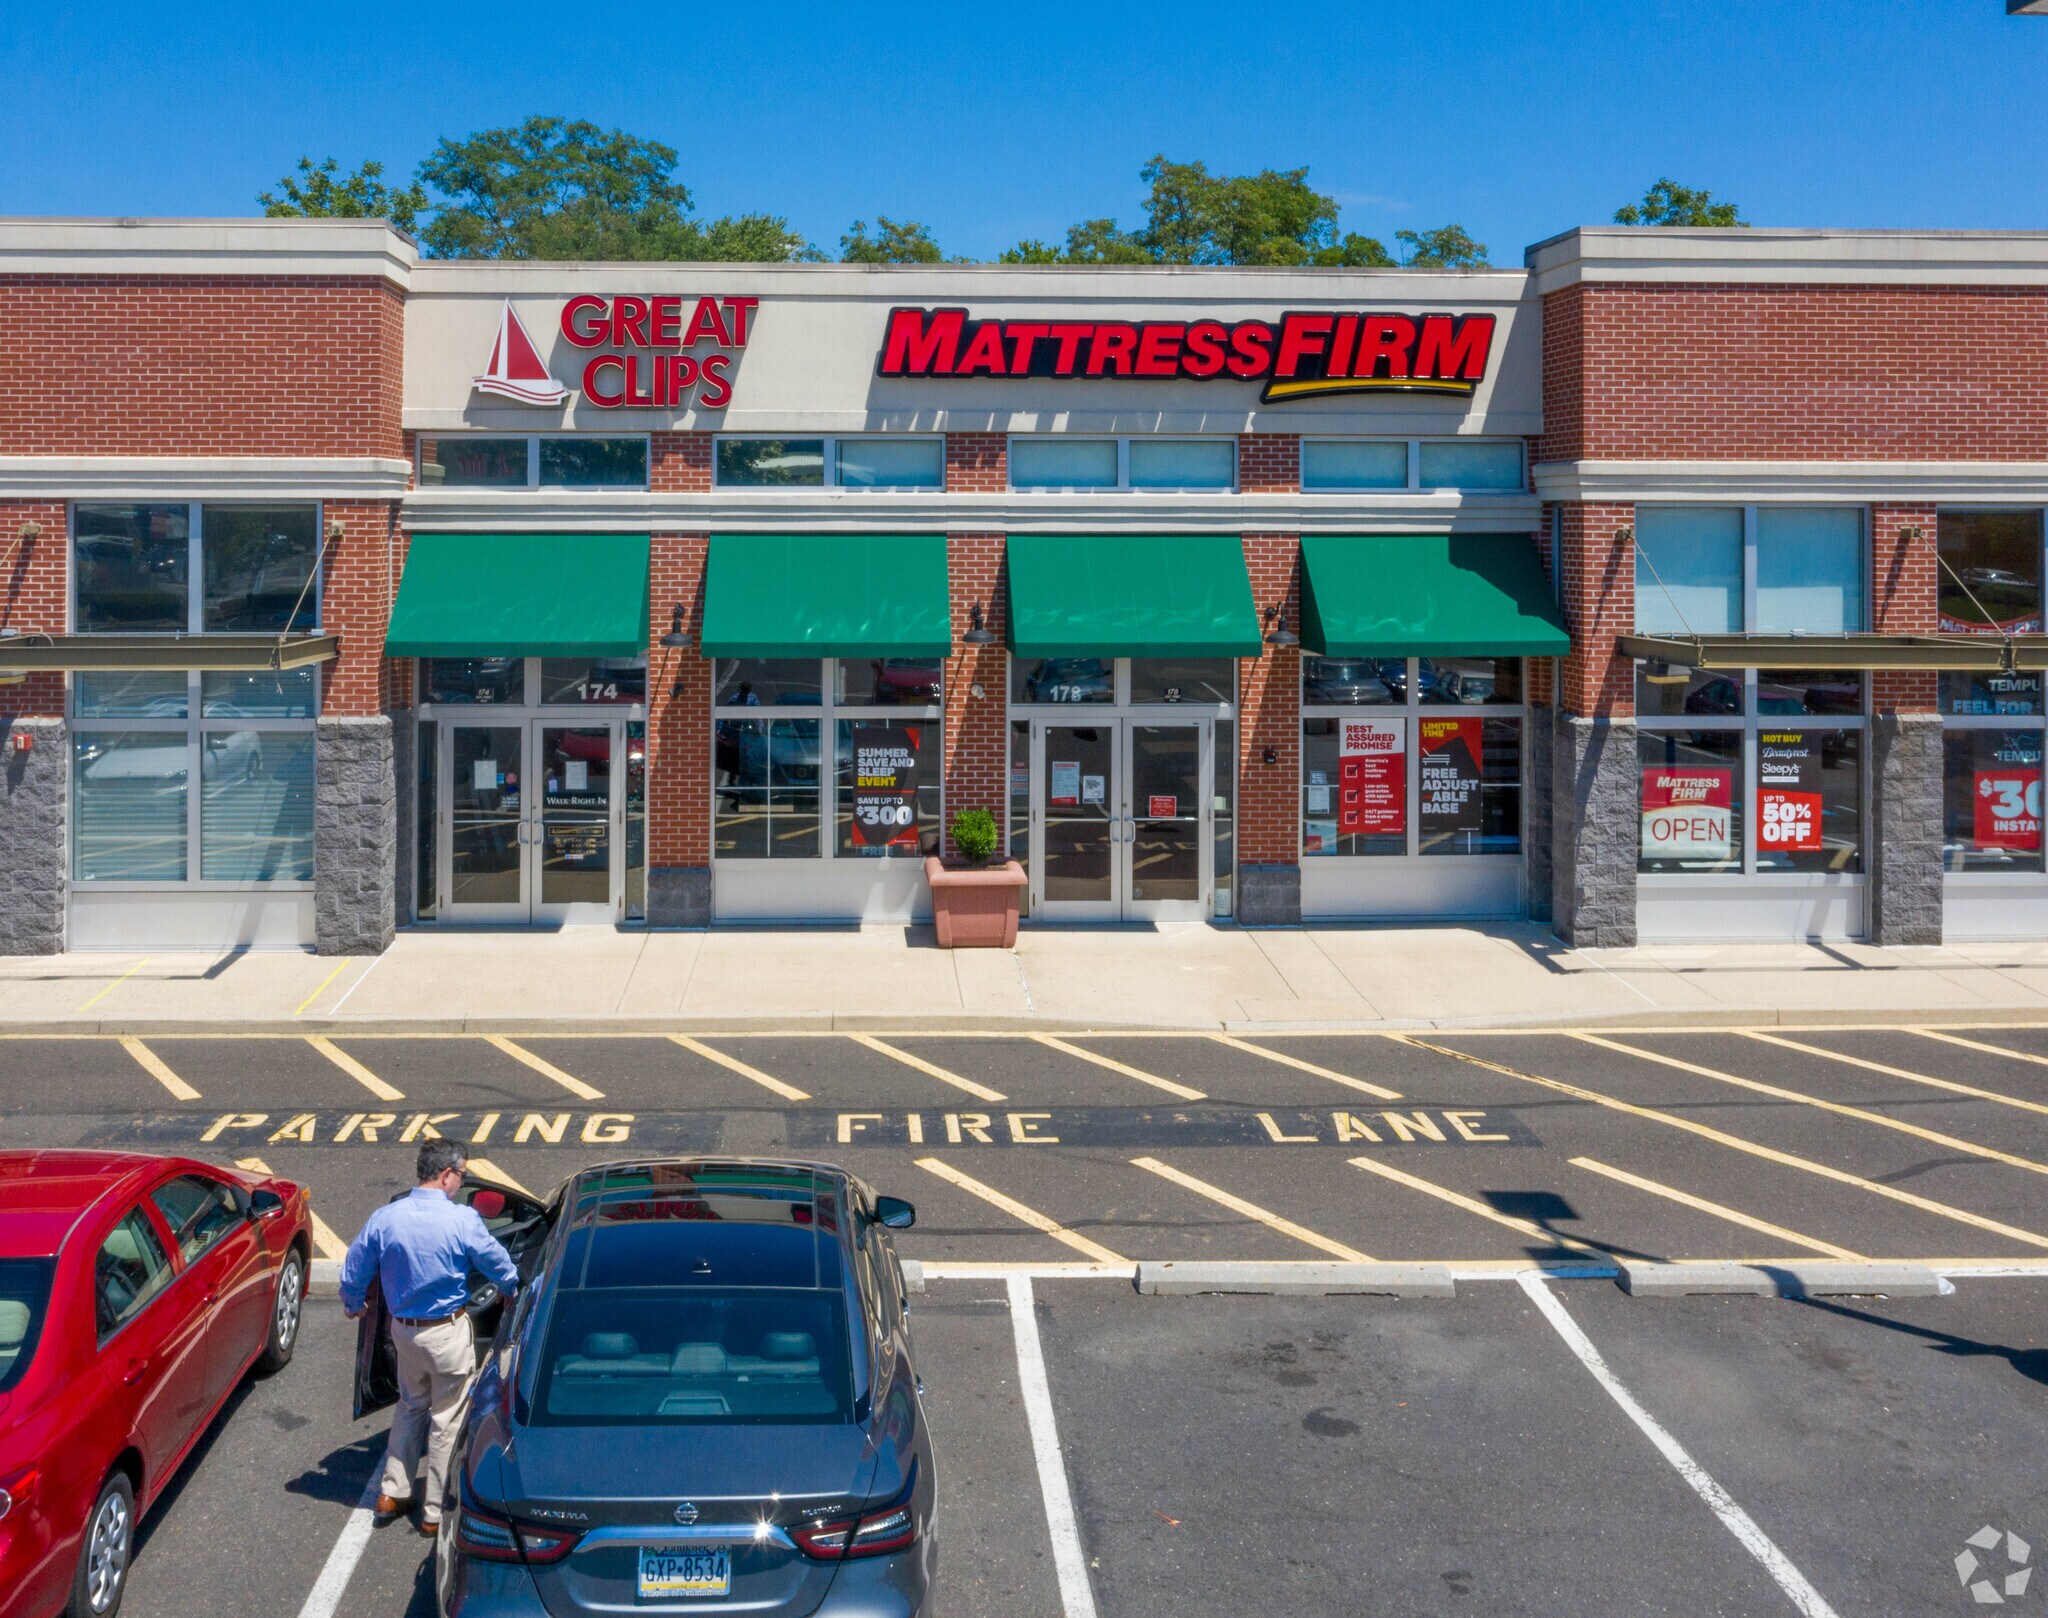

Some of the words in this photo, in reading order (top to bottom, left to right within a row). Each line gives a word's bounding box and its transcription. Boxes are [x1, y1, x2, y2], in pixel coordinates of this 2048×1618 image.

[561, 294, 759, 348] GREAT
[581, 353, 733, 408] CLIPS
[478, 688, 490, 696] 174
[577, 684, 617, 699] 174
[1050, 685, 1082, 702] 178
[1953, 700, 1993, 714] FEEL
[1996, 701, 2033, 715] FOR
[1346, 725, 1374, 734] REST
[1423, 722, 1458, 730] LIMITED
[1346, 733, 1396, 742] ASSURED
[1423, 729, 1445, 737] TIME
[1762, 735, 1782, 743] HOT
[1783, 735, 1802, 743] BUY
[1346, 742, 1393, 750] PROMISE
[858, 748, 909, 758] SUMMER
[1762, 747, 1809, 759] Beautyrest
[858, 757, 889, 768] SAVE
[889, 758, 915, 768] AND
[858, 767, 896, 777] SLEEP
[1423, 768, 1458, 779] FREE
[1762, 763, 1800, 776] Sleepy's
[858, 776, 897, 787] EVENT
[1422, 780, 1479, 791] ADJUST
[1672, 788, 1707, 799] FIRM
[857, 797, 880, 805] SAVE
[880, 797, 892, 805] UP
[892, 797, 903, 805] TO
[1422, 803, 1460, 814] BASE
[1763, 803, 1811, 823] 50%
[856, 805, 913, 826] $300
[1651, 817, 1725, 841] OPEN
[1763, 822, 1811, 842] OFF
[200, 1113, 636, 1144] PARKING
[837, 1113, 1060, 1144] FIRE
[1255, 1111, 1511, 1143] LANE
[530, 1508, 588, 1520] MAXIMA
